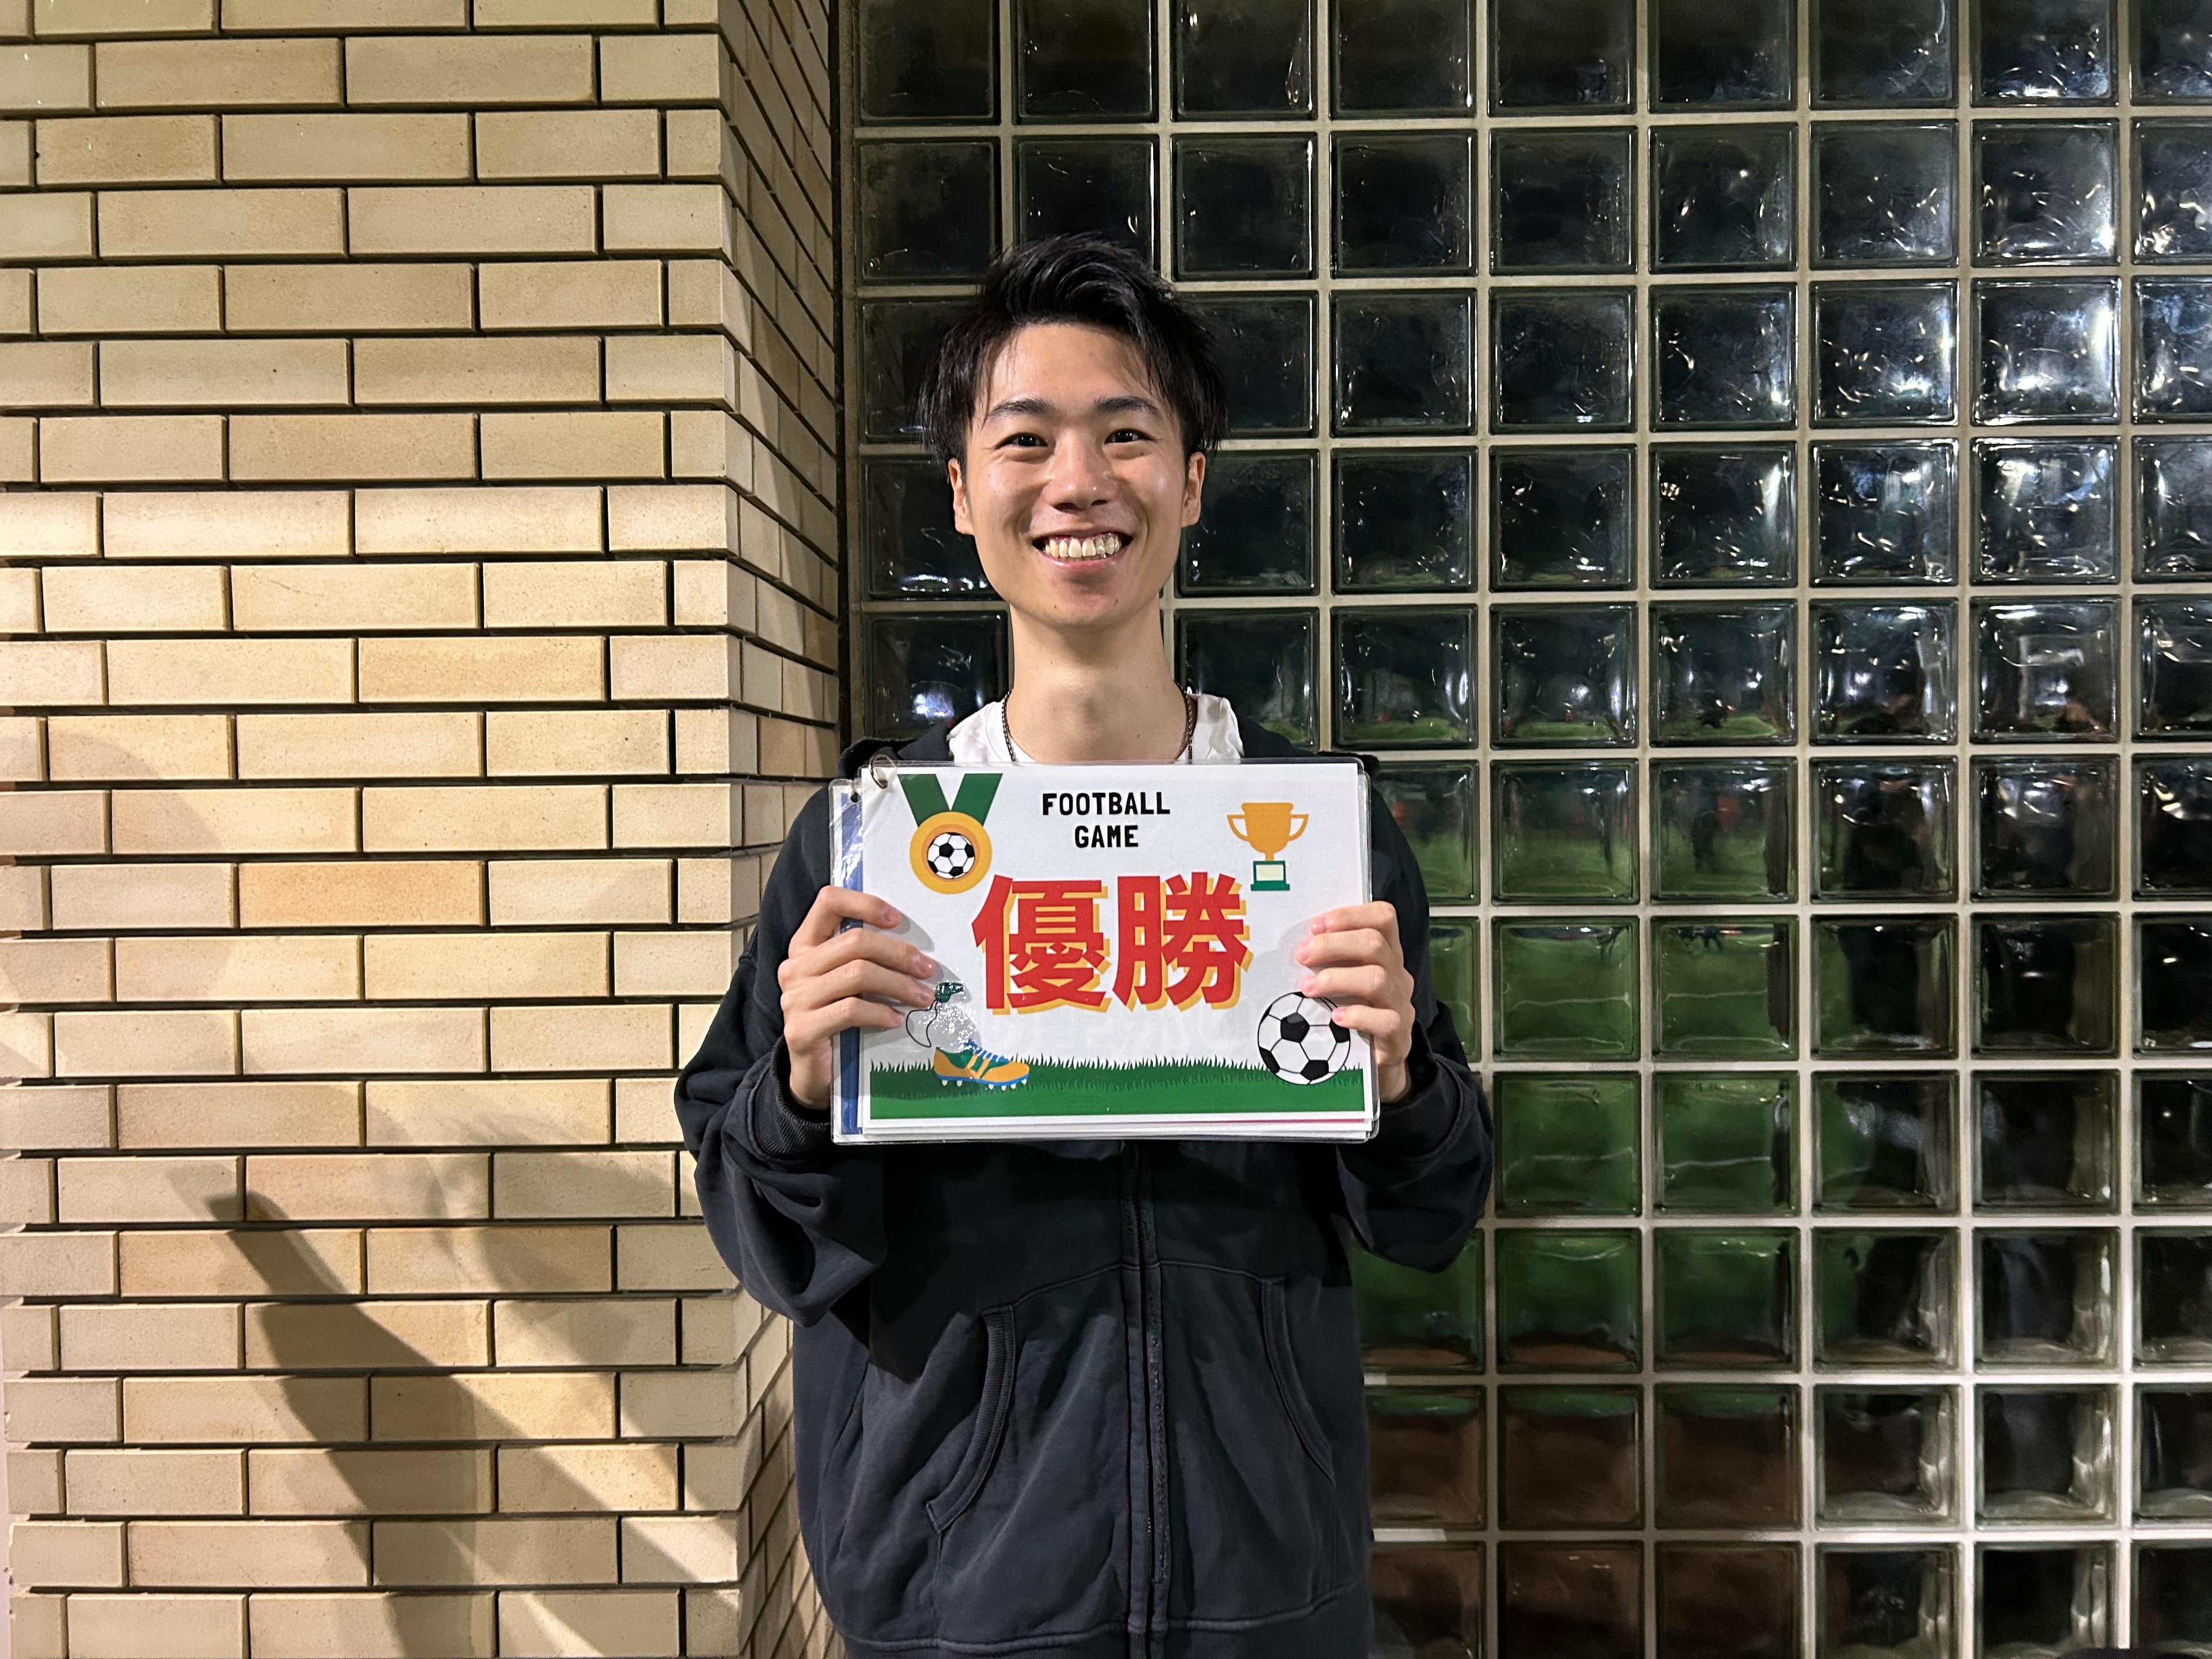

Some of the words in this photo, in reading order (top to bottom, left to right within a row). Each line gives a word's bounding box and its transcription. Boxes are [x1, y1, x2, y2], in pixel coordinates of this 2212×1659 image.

[1042, 791, 1171, 816] FOOTBALL
[1074, 825, 1139, 849] GAME
[972, 872, 1252, 1015] 優勝
